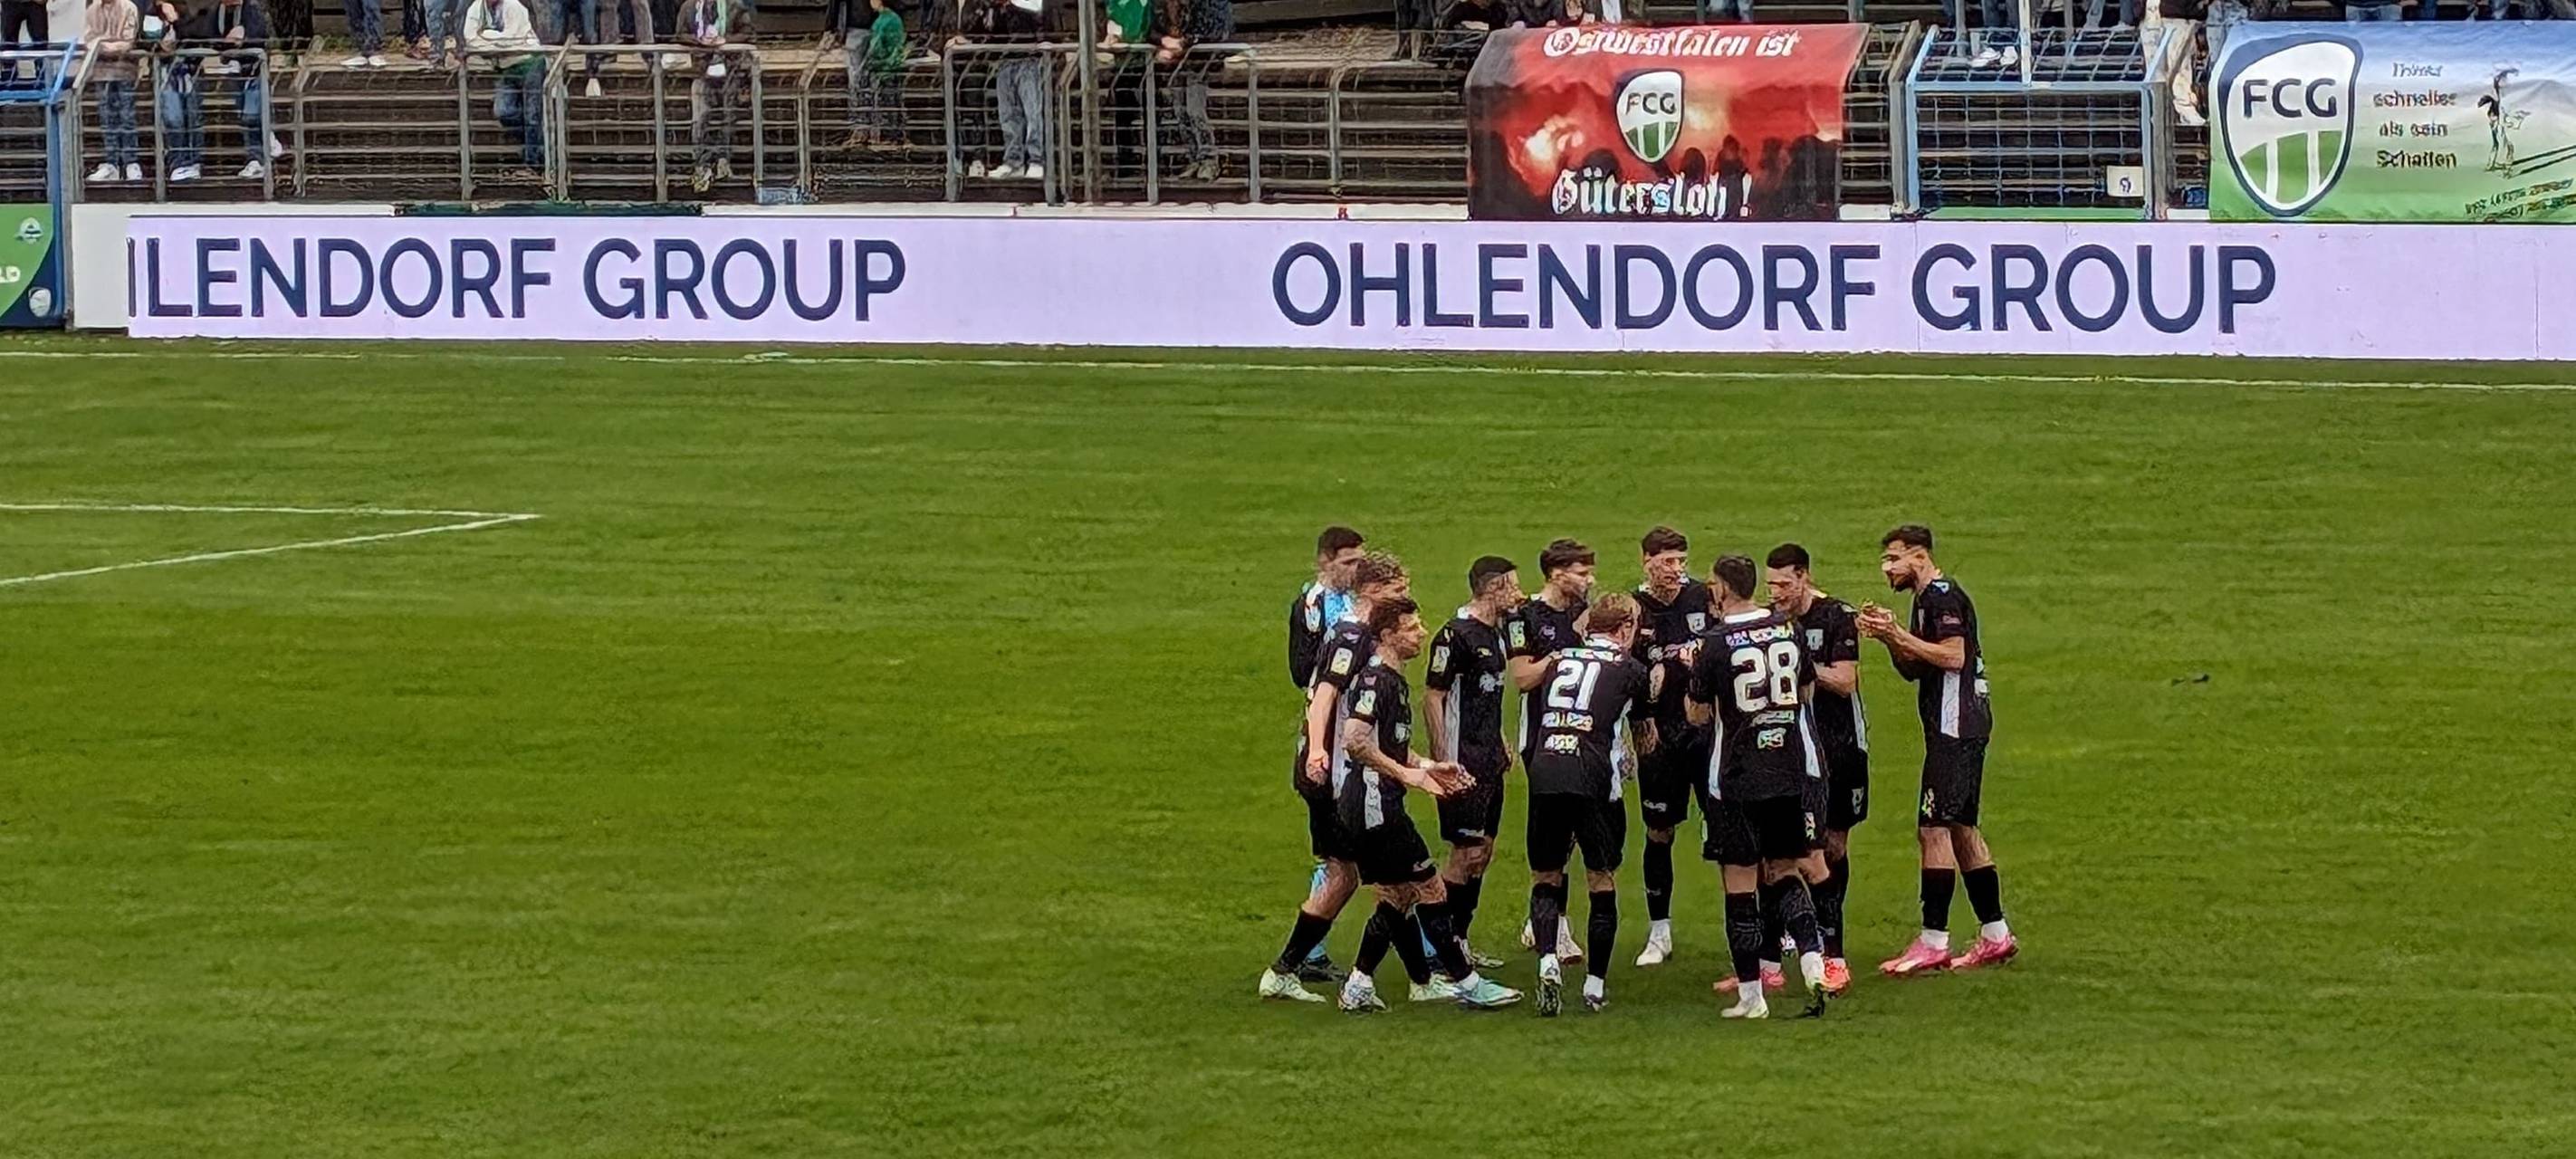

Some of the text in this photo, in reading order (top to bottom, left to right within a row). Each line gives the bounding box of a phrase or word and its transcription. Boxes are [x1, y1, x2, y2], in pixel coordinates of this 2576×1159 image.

[1755, 28, 1801, 56] ist
[1625, 91, 1676, 115] FCG
[2242, 78, 2339, 119] FCG
[1552, 167, 1726, 221] Gütersloh
[583, 237, 906, 321] GROUP
[1272, 241, 2277, 334] OHLENDORF GROUP
[1547, 659, 1602, 711] 21
[1730, 640, 1800, 714] 28
